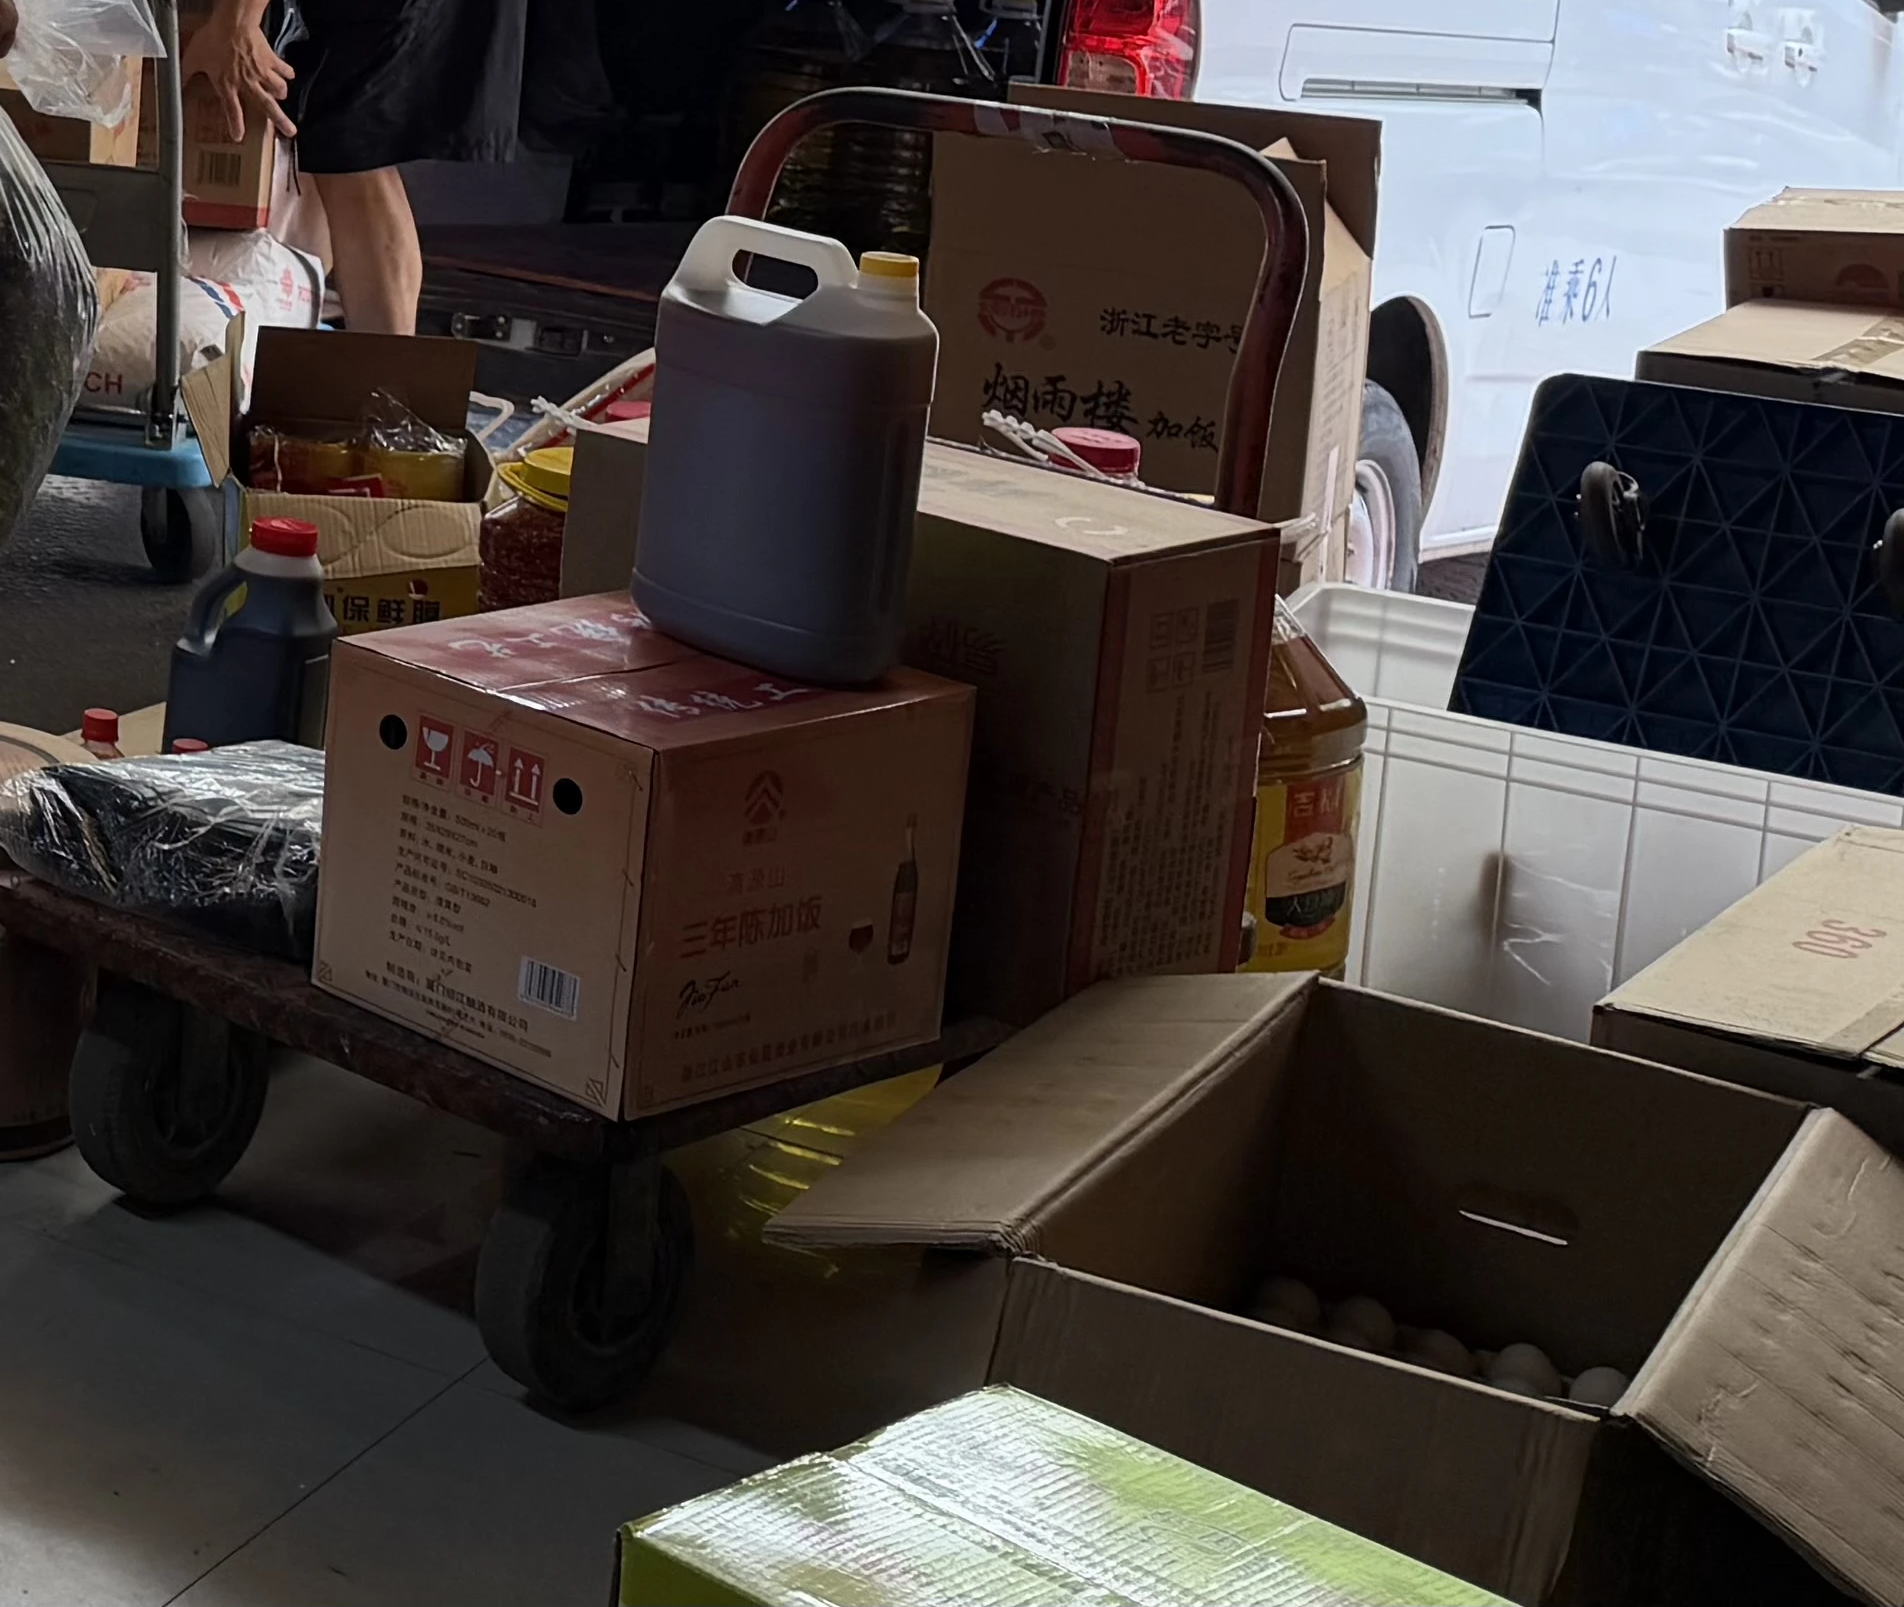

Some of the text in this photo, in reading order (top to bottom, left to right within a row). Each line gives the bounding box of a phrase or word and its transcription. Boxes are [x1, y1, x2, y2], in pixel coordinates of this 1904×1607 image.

[980, 362, 1139, 435] 烟雨楼
[680, 896, 823, 960] 三年陈加饭
[1792, 919, 1889, 960] 360
